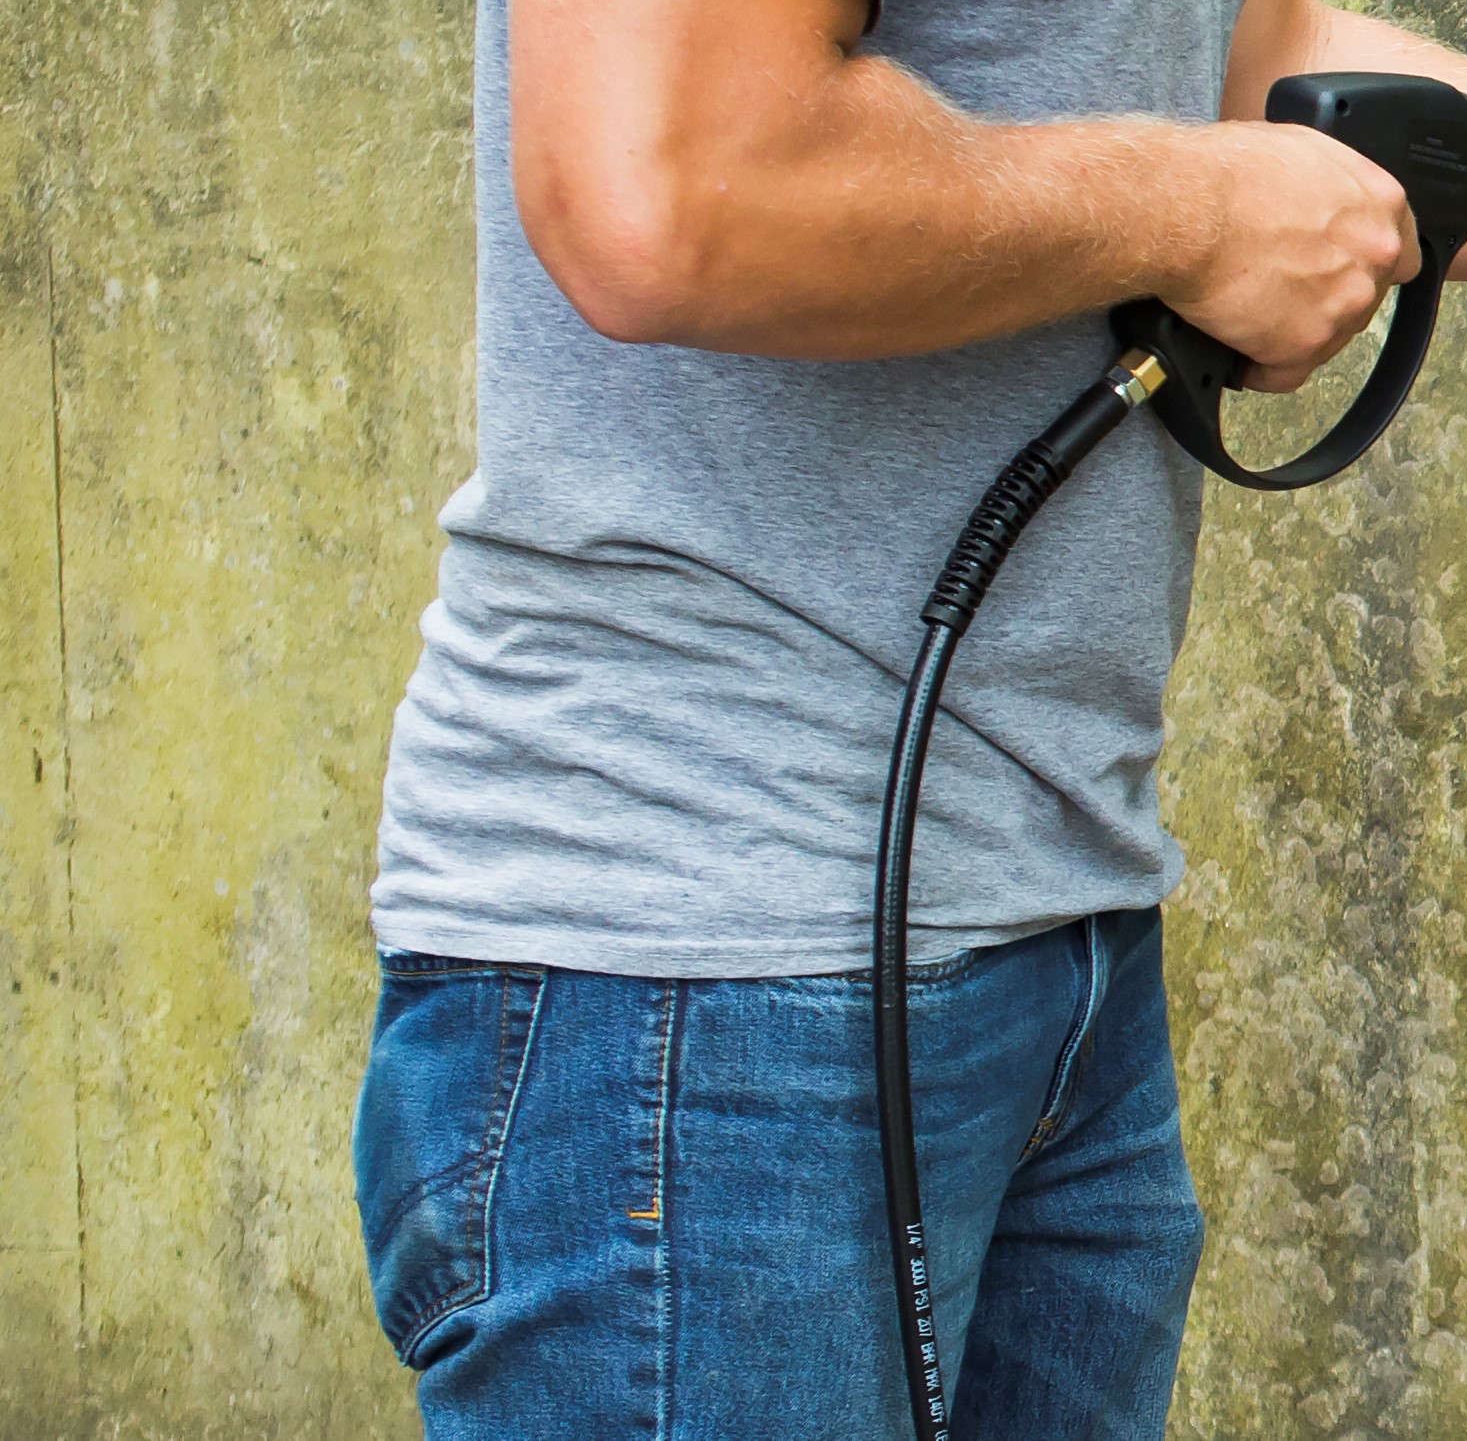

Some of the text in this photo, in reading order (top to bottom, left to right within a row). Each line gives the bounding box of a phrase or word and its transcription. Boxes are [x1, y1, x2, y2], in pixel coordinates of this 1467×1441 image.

[906, 1222, 922, 1249] 1/4"
[910, 1256, 927, 1286] 3000
[914, 1288, 930, 1312] PSI
[917, 1316, 932, 1338] 207
[921, 1341, 936, 1365] BAR
[924, 1367, 941, 1392] MAX
